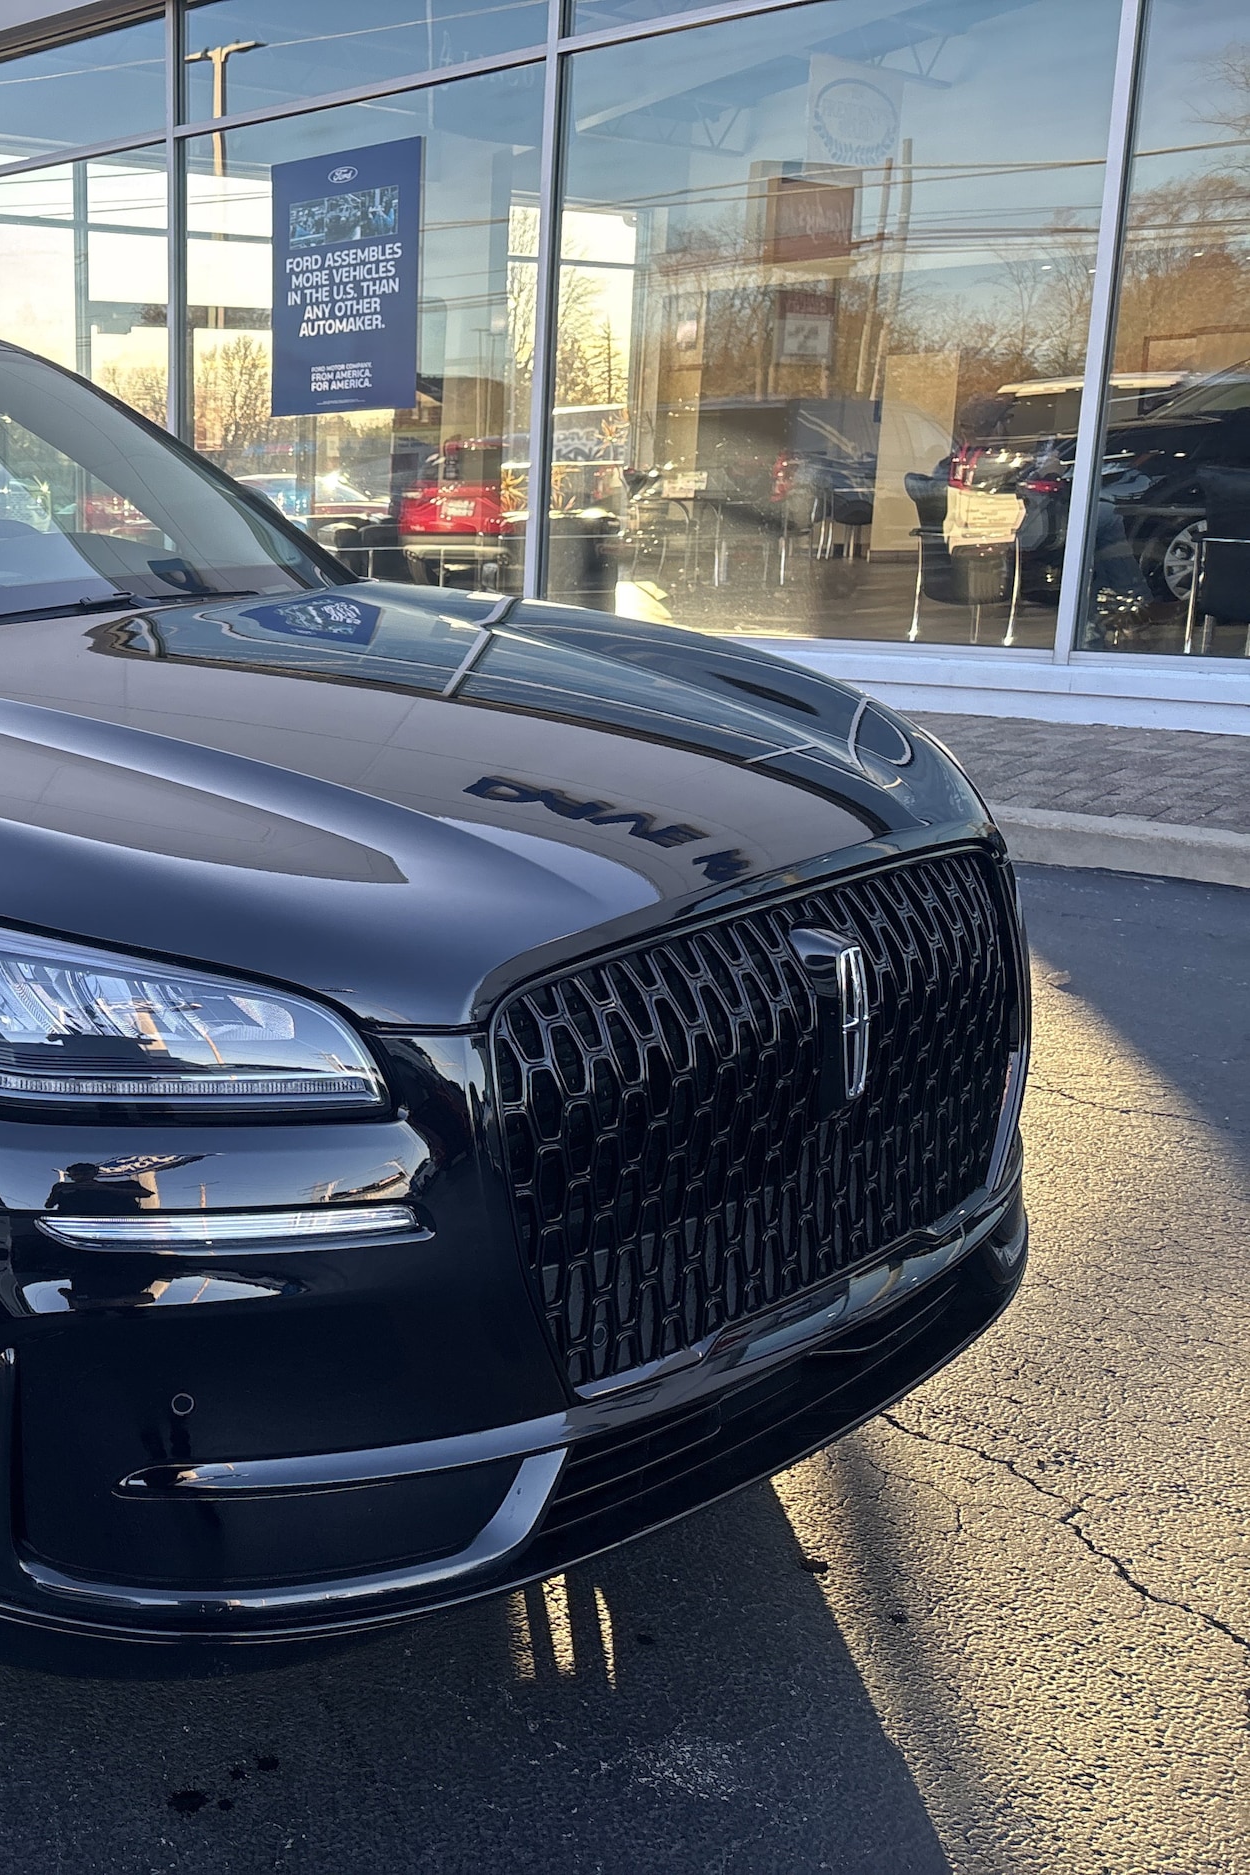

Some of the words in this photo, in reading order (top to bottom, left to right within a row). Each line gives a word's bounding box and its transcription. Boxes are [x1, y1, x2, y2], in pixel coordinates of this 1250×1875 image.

[331, 167, 355, 182] Ford
[285, 254, 322, 274] FORD
[324, 242, 402, 268] ASSEMBLES
[291, 270, 330, 289] MORE
[332, 261, 396, 283] VEHICLES
[287, 290, 301, 306] IN
[304, 286, 330, 304] THE
[333, 283, 358, 300] U.S.
[360, 277, 400, 297] THAN
[303, 303, 332, 321] ANY
[334, 297, 381, 316] OTHER
[299, 314, 386, 338] AUTOMAKER.
[310, 365, 326, 373] FORD
[326, 363, 346, 371] MOTOR
[311, 371, 334, 382] FROM
[335, 368, 373, 380] AMERICA.
[310, 381, 330, 392] FOR
[330, 377, 373, 391] AMERICA.
